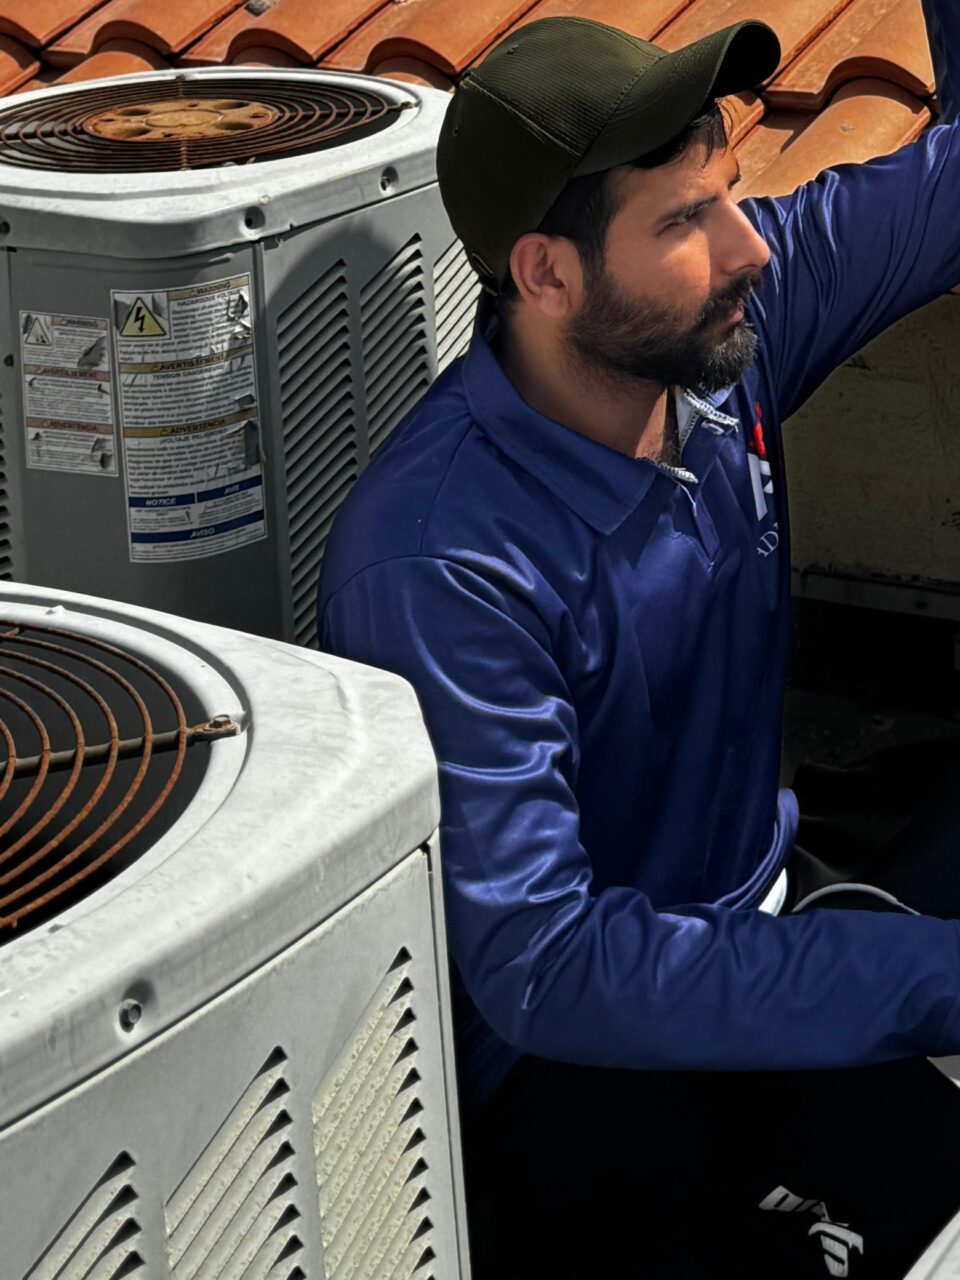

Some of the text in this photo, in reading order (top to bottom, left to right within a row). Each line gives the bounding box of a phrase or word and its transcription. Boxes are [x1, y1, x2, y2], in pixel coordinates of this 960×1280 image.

[197, 281, 231, 295] WARNING
[170, 419, 226, 434] ADVERTENCIA
[145, 497, 177, 506] NOTICE
[190, 527, 216, 539] AVISO
